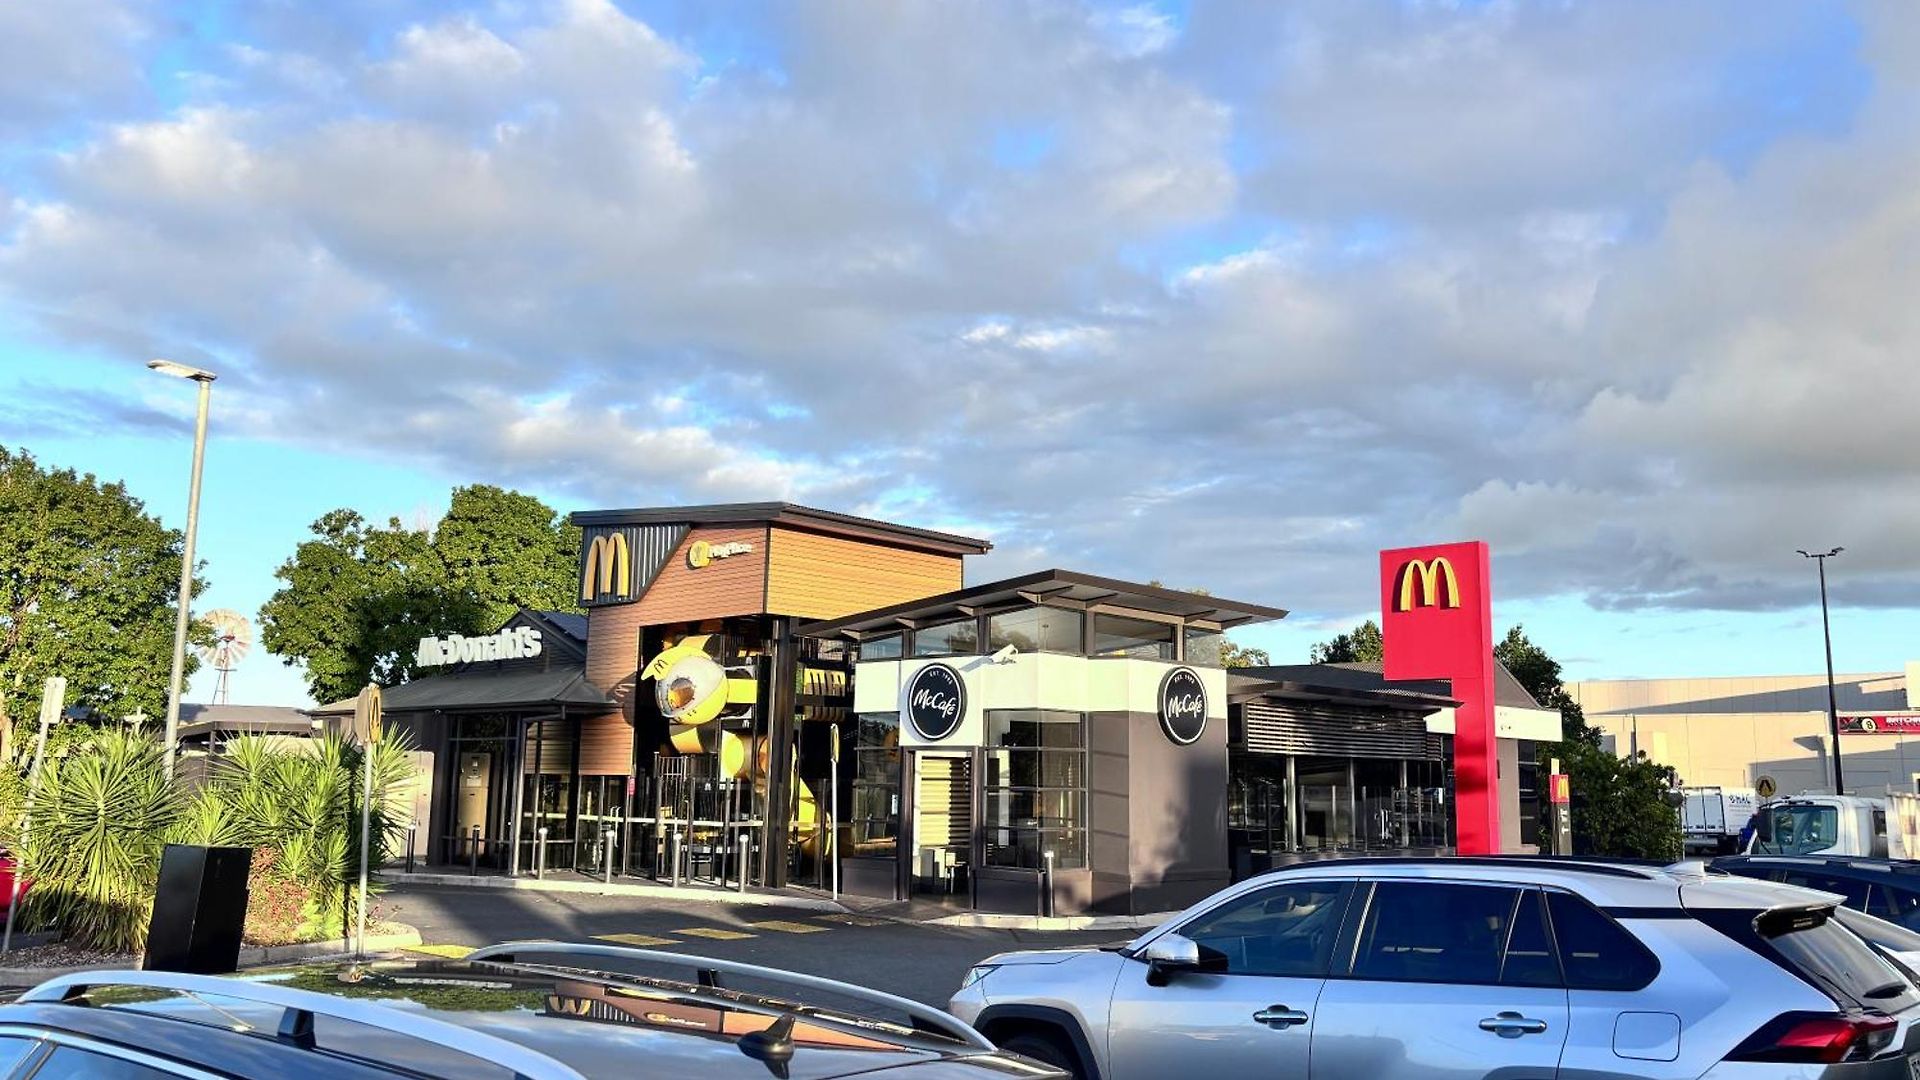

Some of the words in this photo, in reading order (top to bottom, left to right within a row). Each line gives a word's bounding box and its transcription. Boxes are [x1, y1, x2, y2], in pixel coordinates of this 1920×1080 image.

[416, 626, 542, 668] McDonald's
[913, 689, 957, 719] McCafé
[1168, 693, 1203, 718] McCafé
